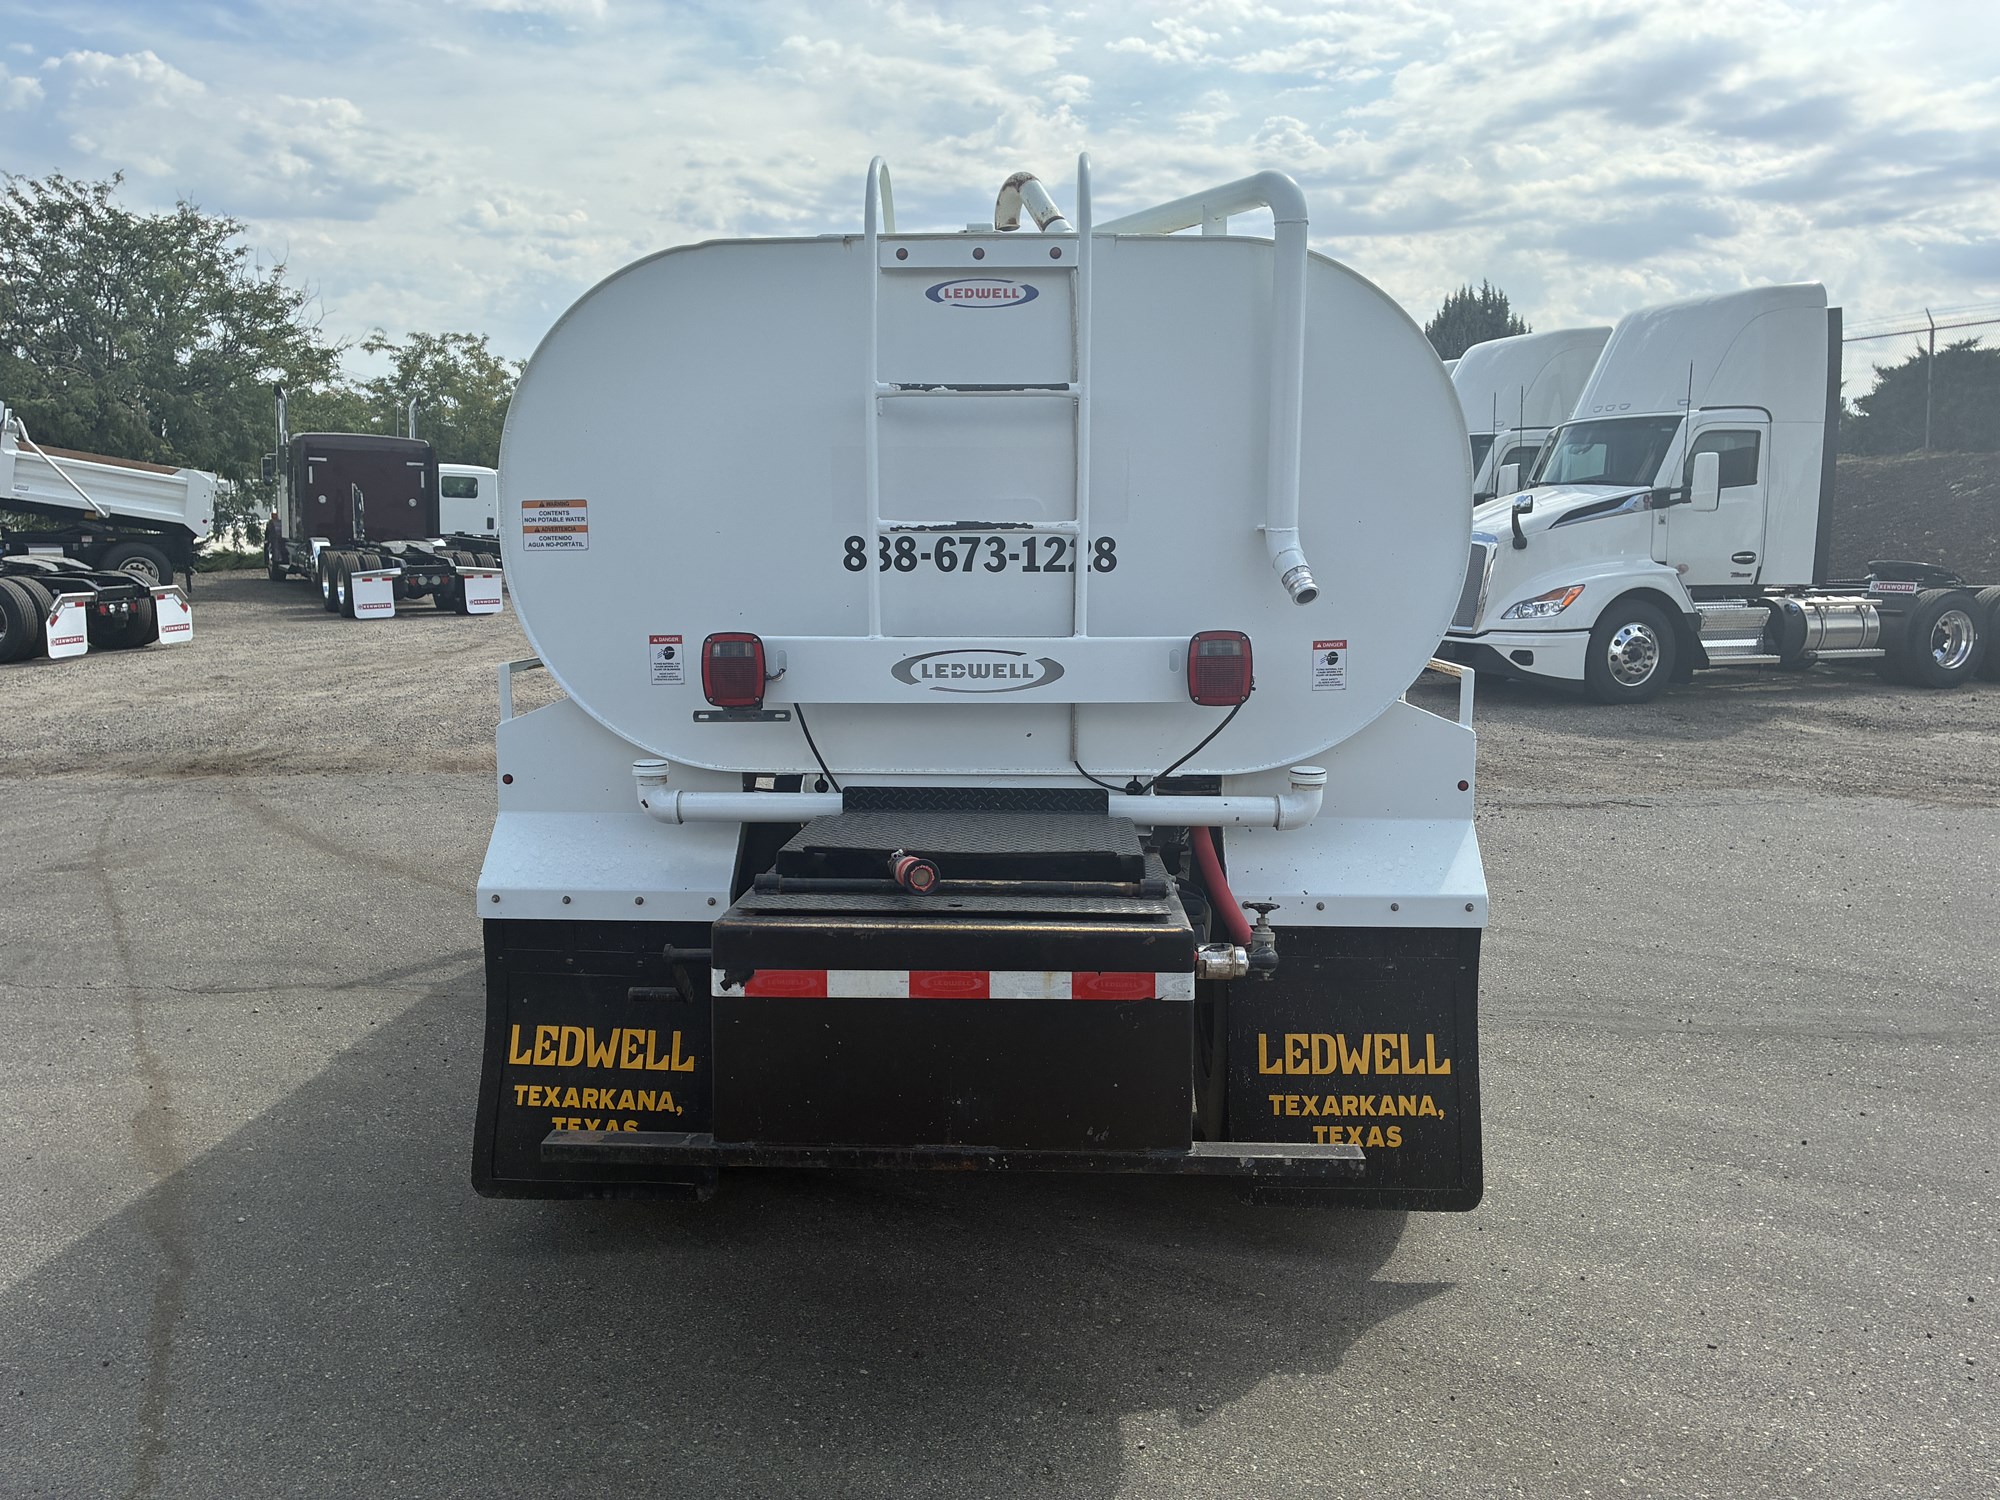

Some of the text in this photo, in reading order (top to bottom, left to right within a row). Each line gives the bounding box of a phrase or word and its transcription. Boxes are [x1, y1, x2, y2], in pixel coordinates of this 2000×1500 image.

[944, 287, 1020, 299] LEDWELL
[921, 663, 1034, 679] LEDWELL
[508, 1024, 695, 1072] LEDWELL
[1258, 1033, 1451, 1075] LEDWELL
[513, 1084, 683, 1117] TEXARKANA,
[1268, 1094, 1446, 1121] TEXARKANA,
[1312, 1125, 1403, 1148] TEXAS
